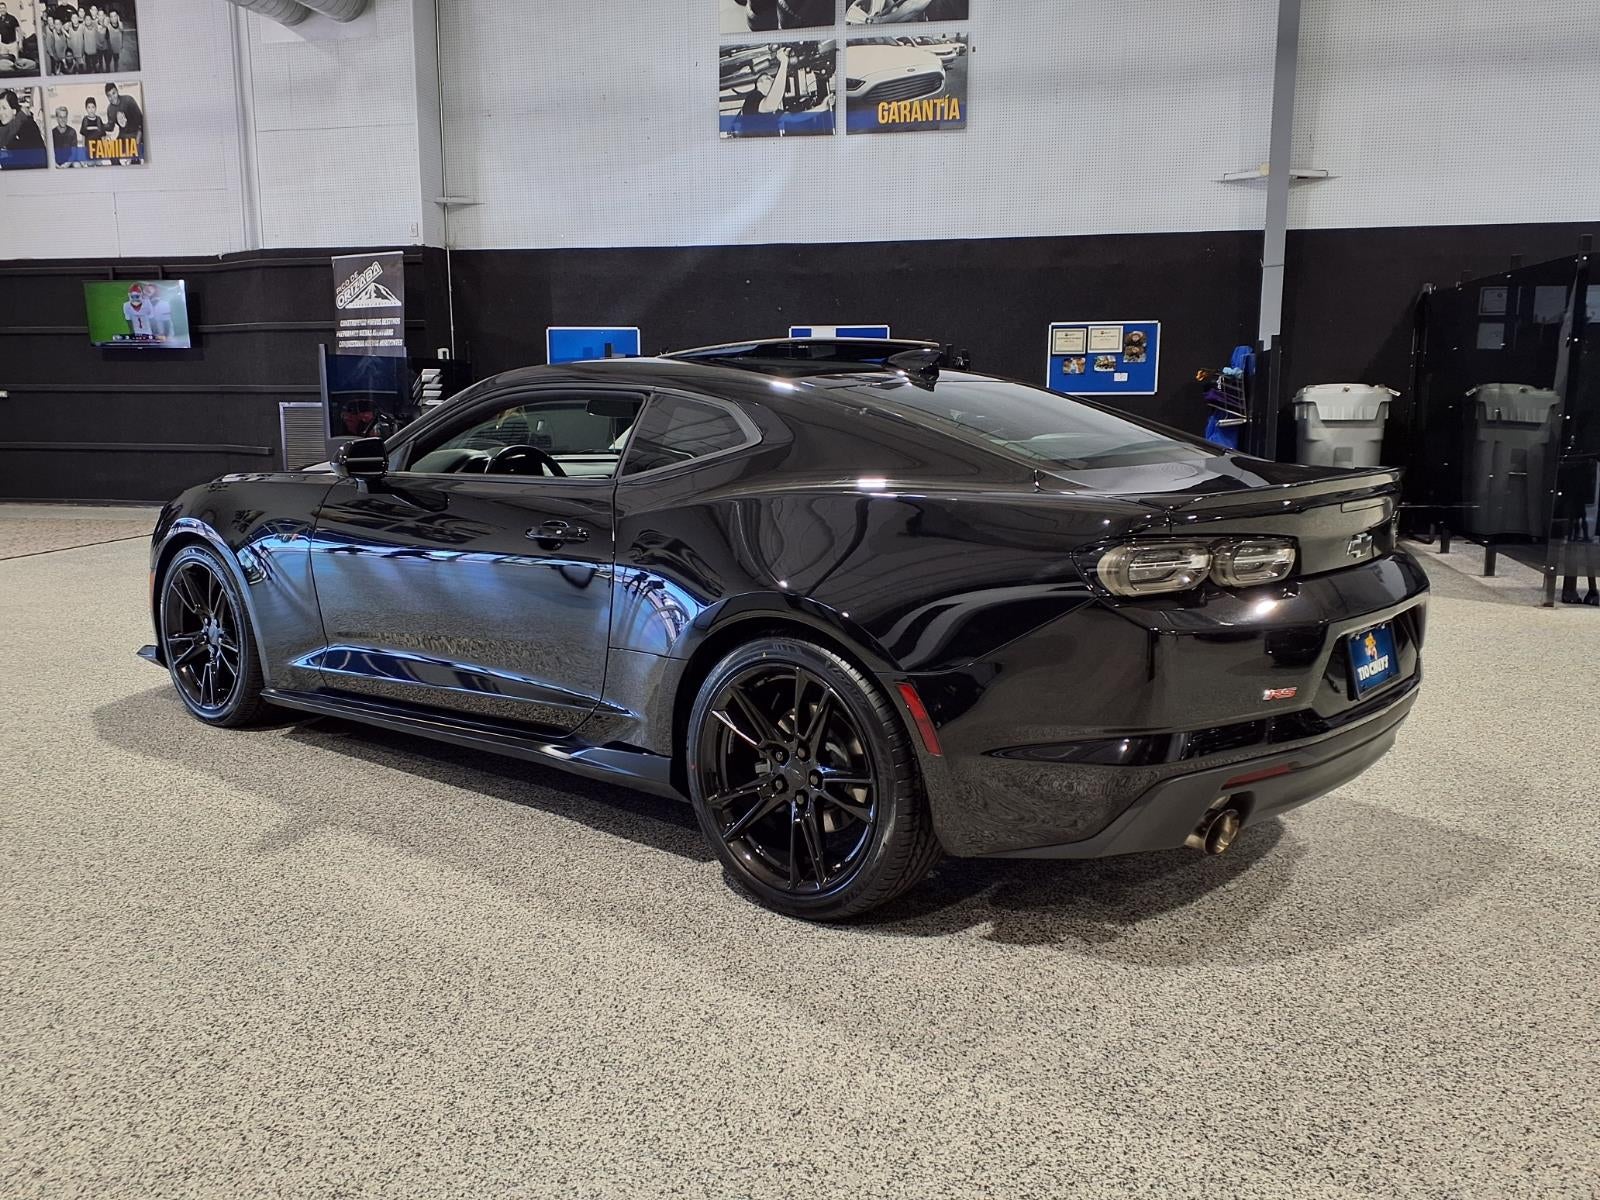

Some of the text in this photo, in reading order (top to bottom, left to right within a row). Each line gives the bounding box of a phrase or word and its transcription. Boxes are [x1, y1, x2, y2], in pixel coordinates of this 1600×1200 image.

[878, 94, 960, 124] GARANTÍA
[88, 138, 138, 159] FAMILIA
[336, 271, 359, 294] PICO DE
[336, 261, 383, 309] ORIZABA
